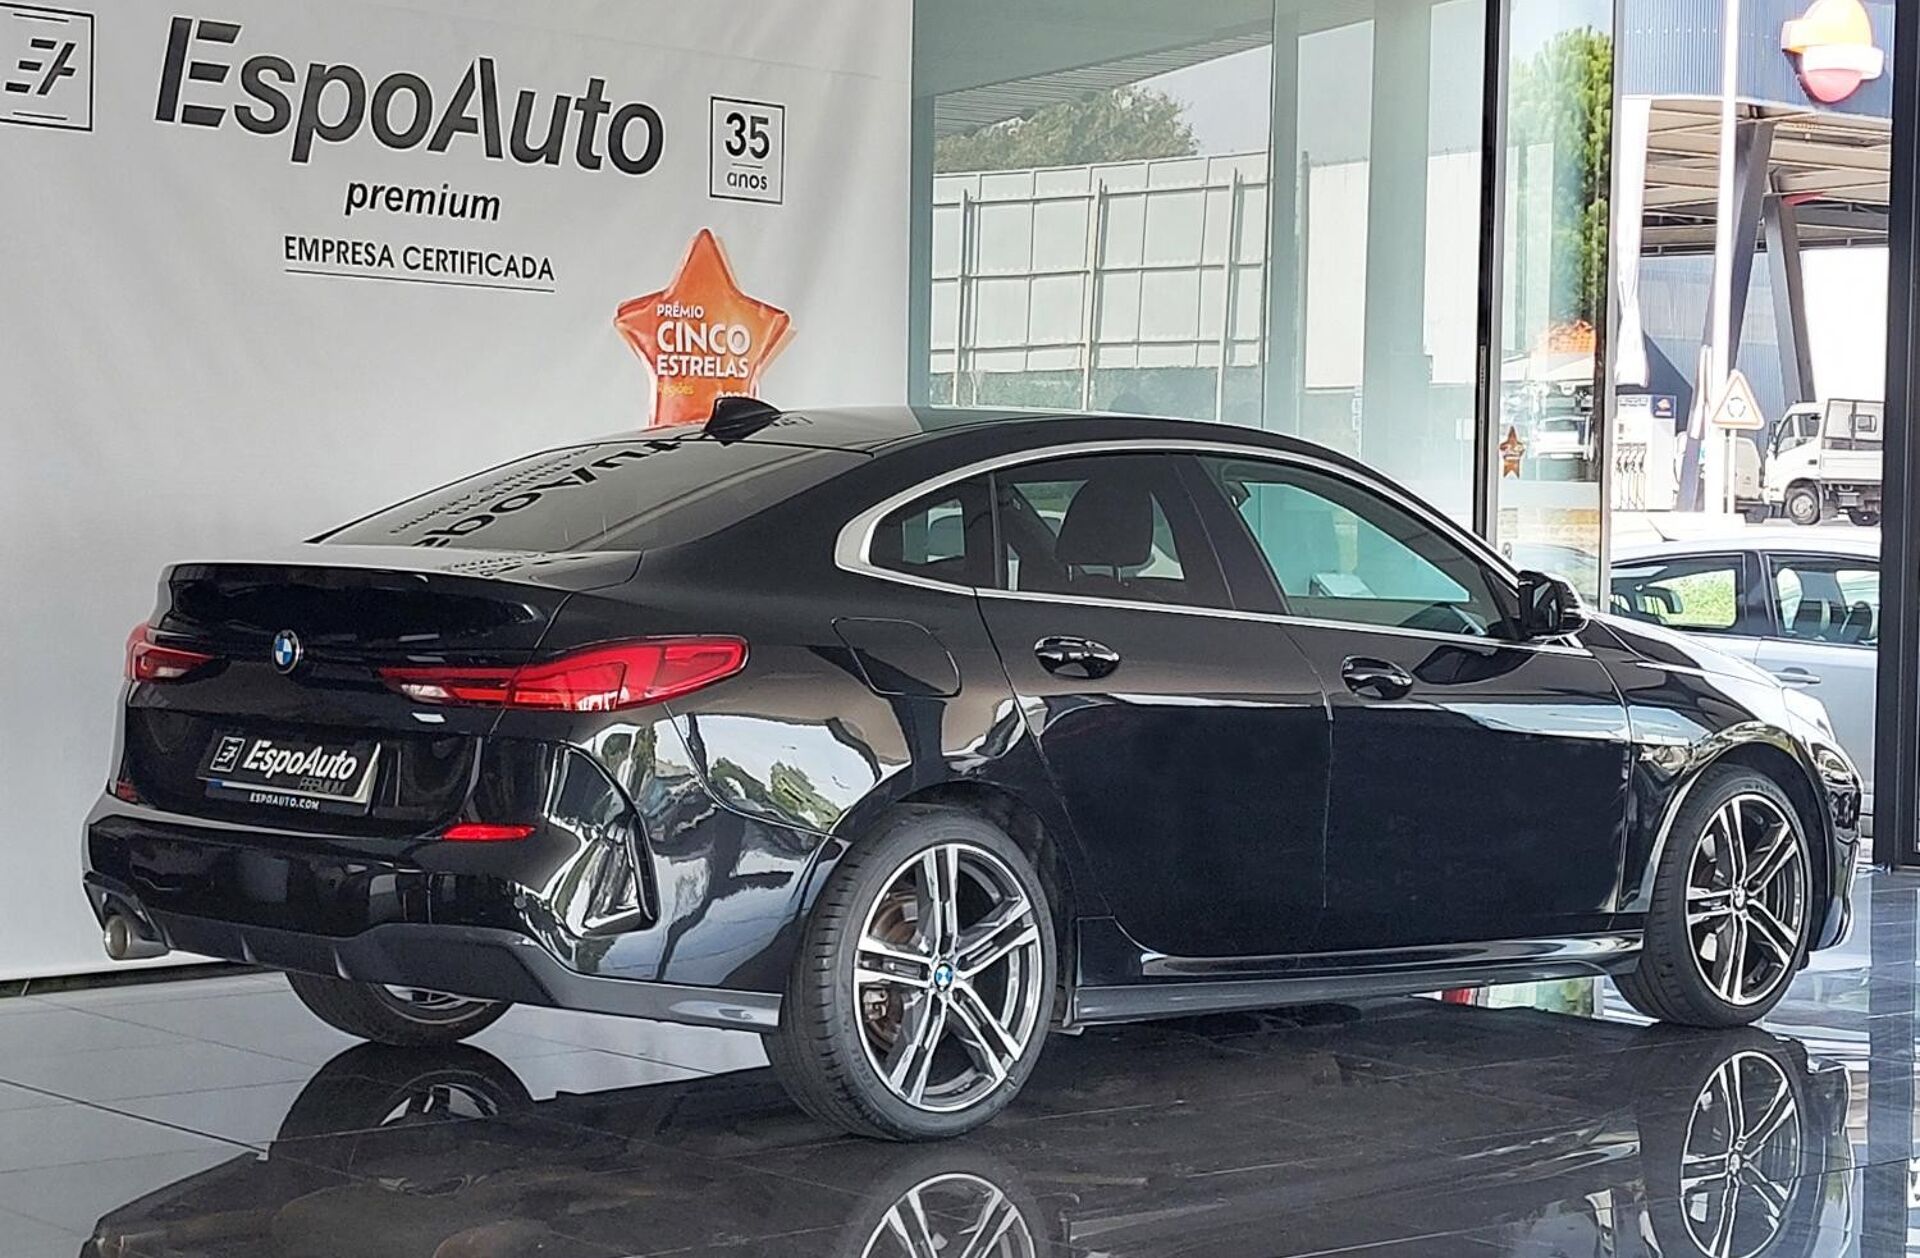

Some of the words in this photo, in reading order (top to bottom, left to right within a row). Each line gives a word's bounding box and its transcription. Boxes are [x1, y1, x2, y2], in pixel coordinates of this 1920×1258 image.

[154, 15, 665, 176] EspoAuto
[725, 112, 770, 159] 35
[727, 172, 768, 190] anos
[345, 182, 501, 221] premium
[284, 235, 395, 268] EMPRESA
[403, 246, 555, 281] CERTIFICADA
[656, 301, 704, 319] PRÉMIO
[656, 321, 751, 355] CINCO
[656, 355, 749, 378] ESTRELAS
[242, 739, 358, 780] EspoAuto
[249, 792, 321, 810] ESPOAUTO.COM
